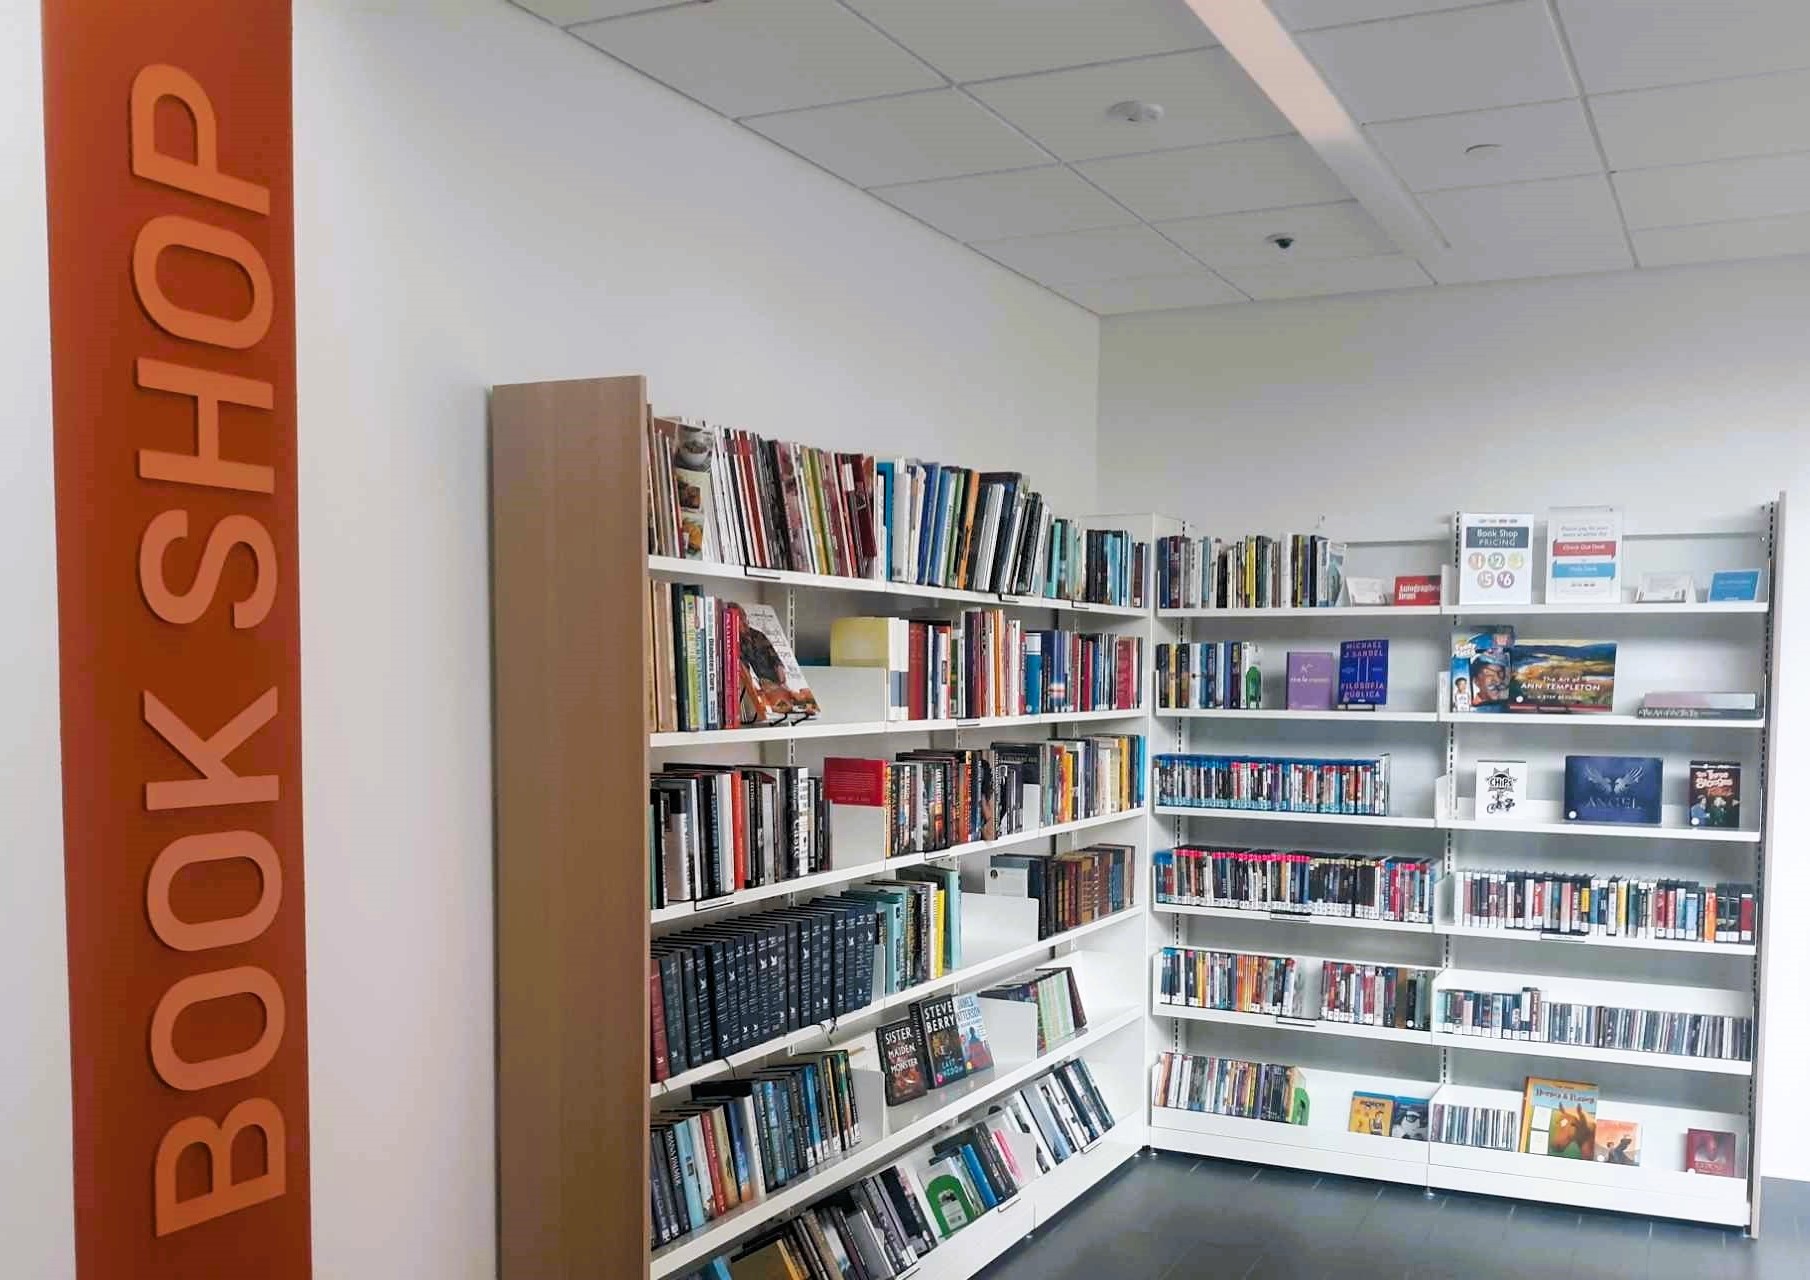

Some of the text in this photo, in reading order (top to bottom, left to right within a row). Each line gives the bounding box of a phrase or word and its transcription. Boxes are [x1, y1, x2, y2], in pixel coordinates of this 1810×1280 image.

[1477, 528, 1518, 539] Book Shop
[1478, 539, 1516, 547] PRICING
[130, 63, 287, 1238] BOOK SHOP
[1547, 683, 1600, 691] TEMPLETON
[924, 1000, 953, 1020] STEVE
[926, 1014, 955, 1034] BERRY
[885, 1026, 913, 1045] SISTER
[888, 1042, 917, 1058] MAIDEN
[891, 1058, 918, 1073] MONSTER
